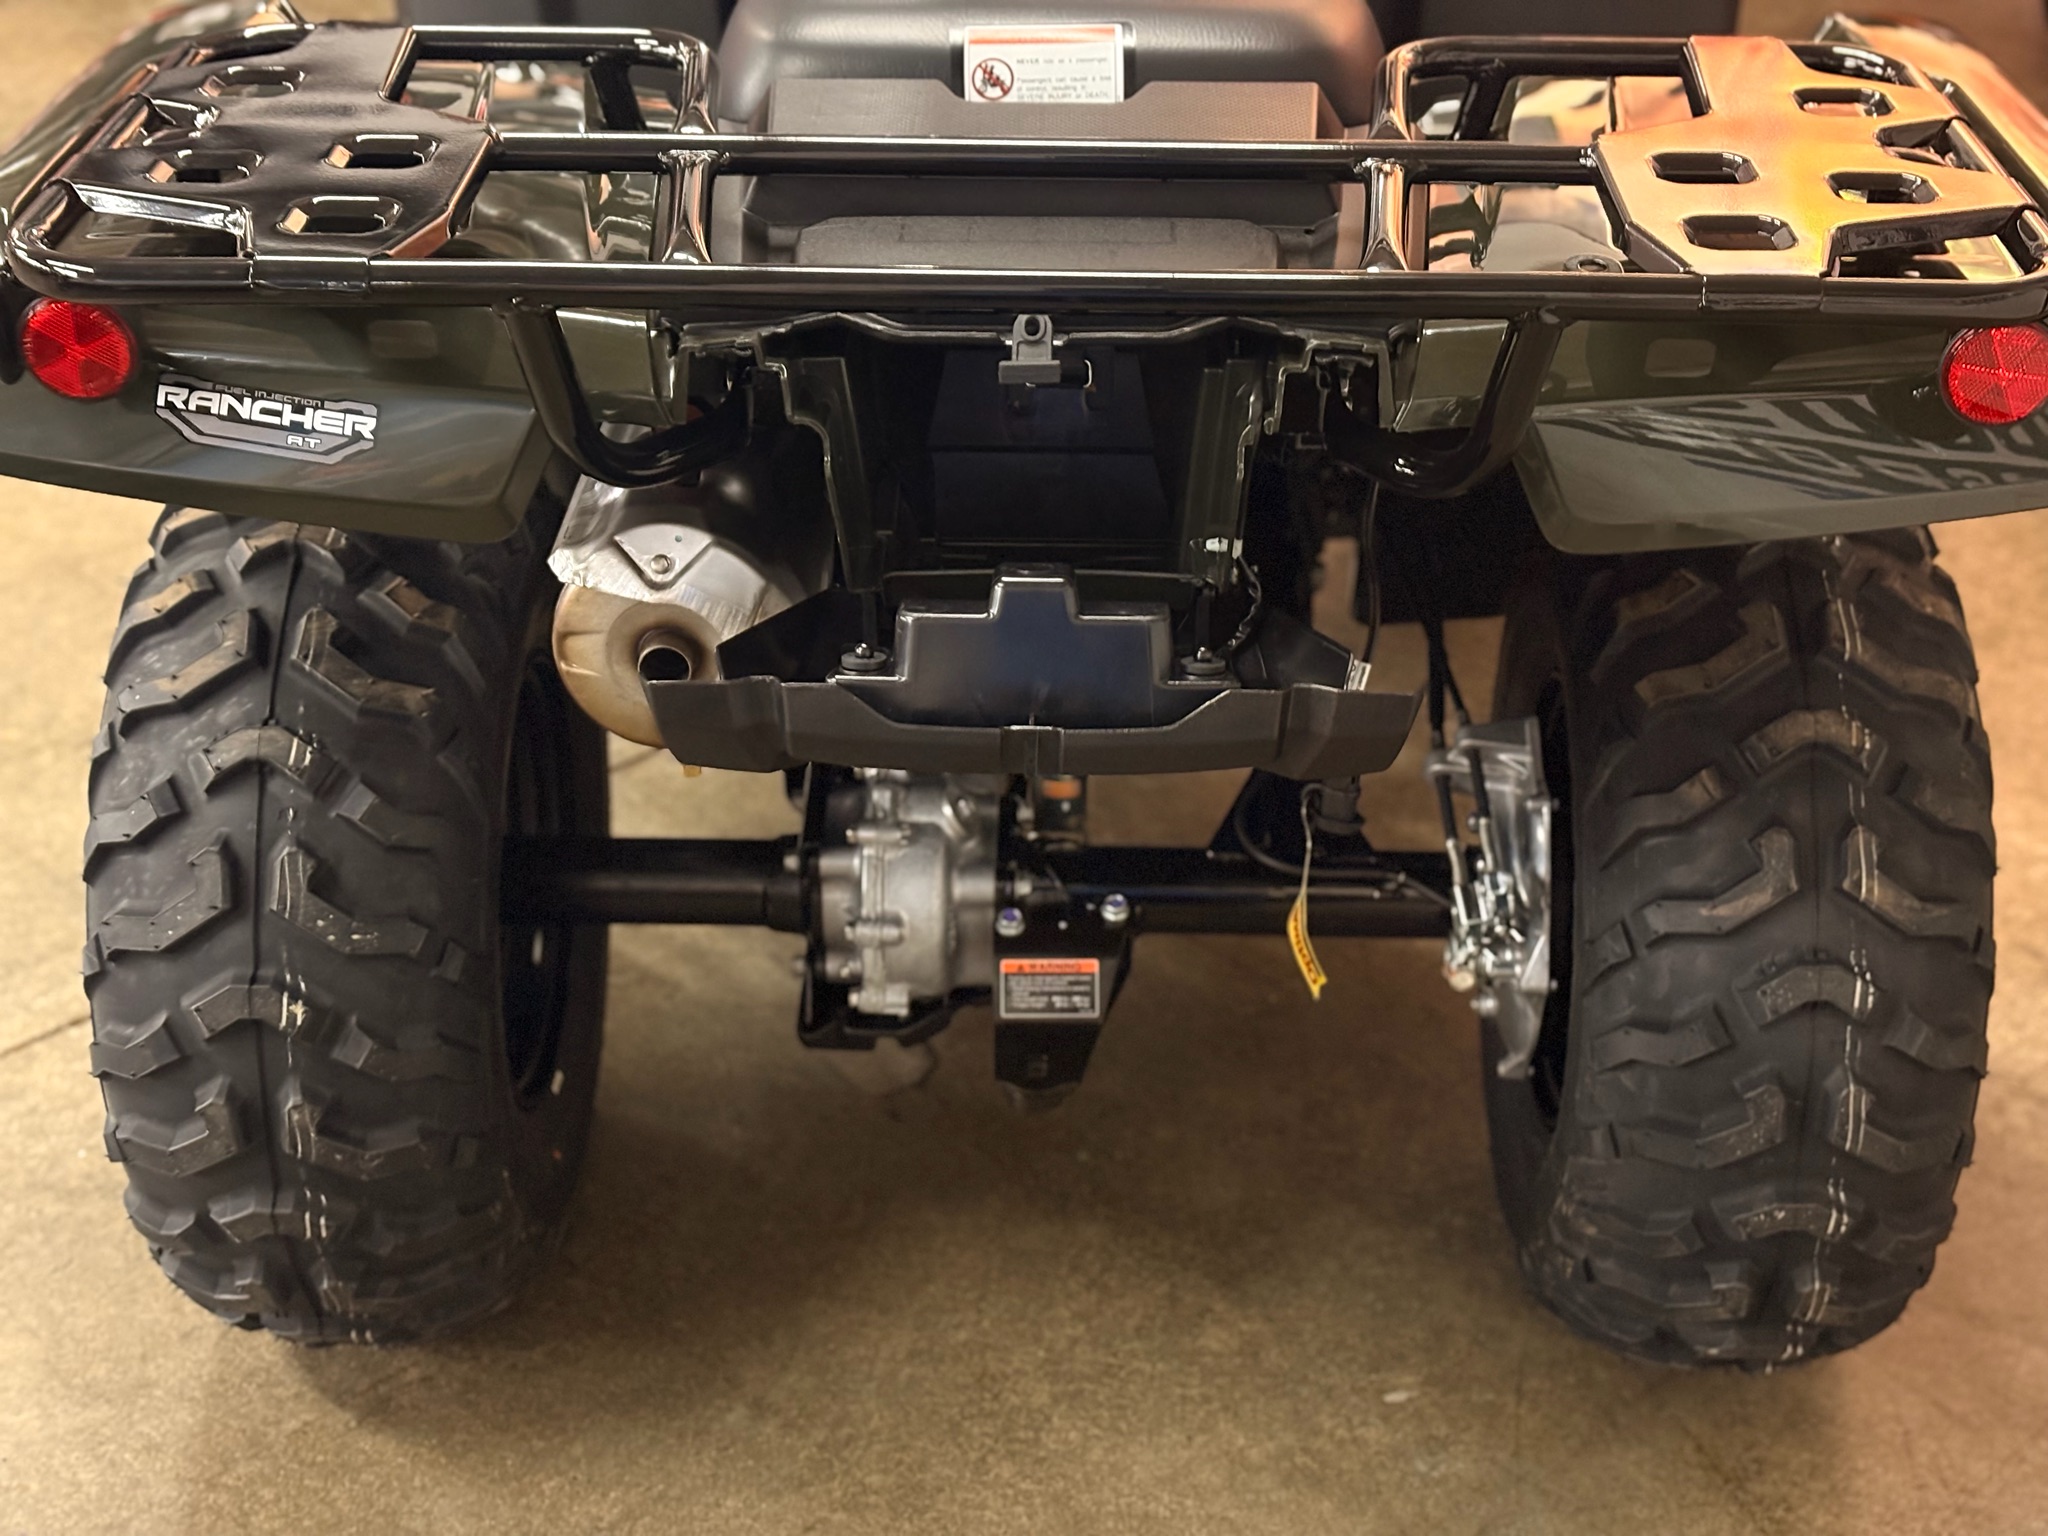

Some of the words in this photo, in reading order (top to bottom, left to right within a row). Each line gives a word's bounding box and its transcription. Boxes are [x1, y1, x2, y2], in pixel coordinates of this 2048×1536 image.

[214, 384, 252, 397] FUEL
[254, 389, 322, 408] INJECTION
[156, 384, 377, 440] RANCHER
[286, 434, 322, 449] AT
